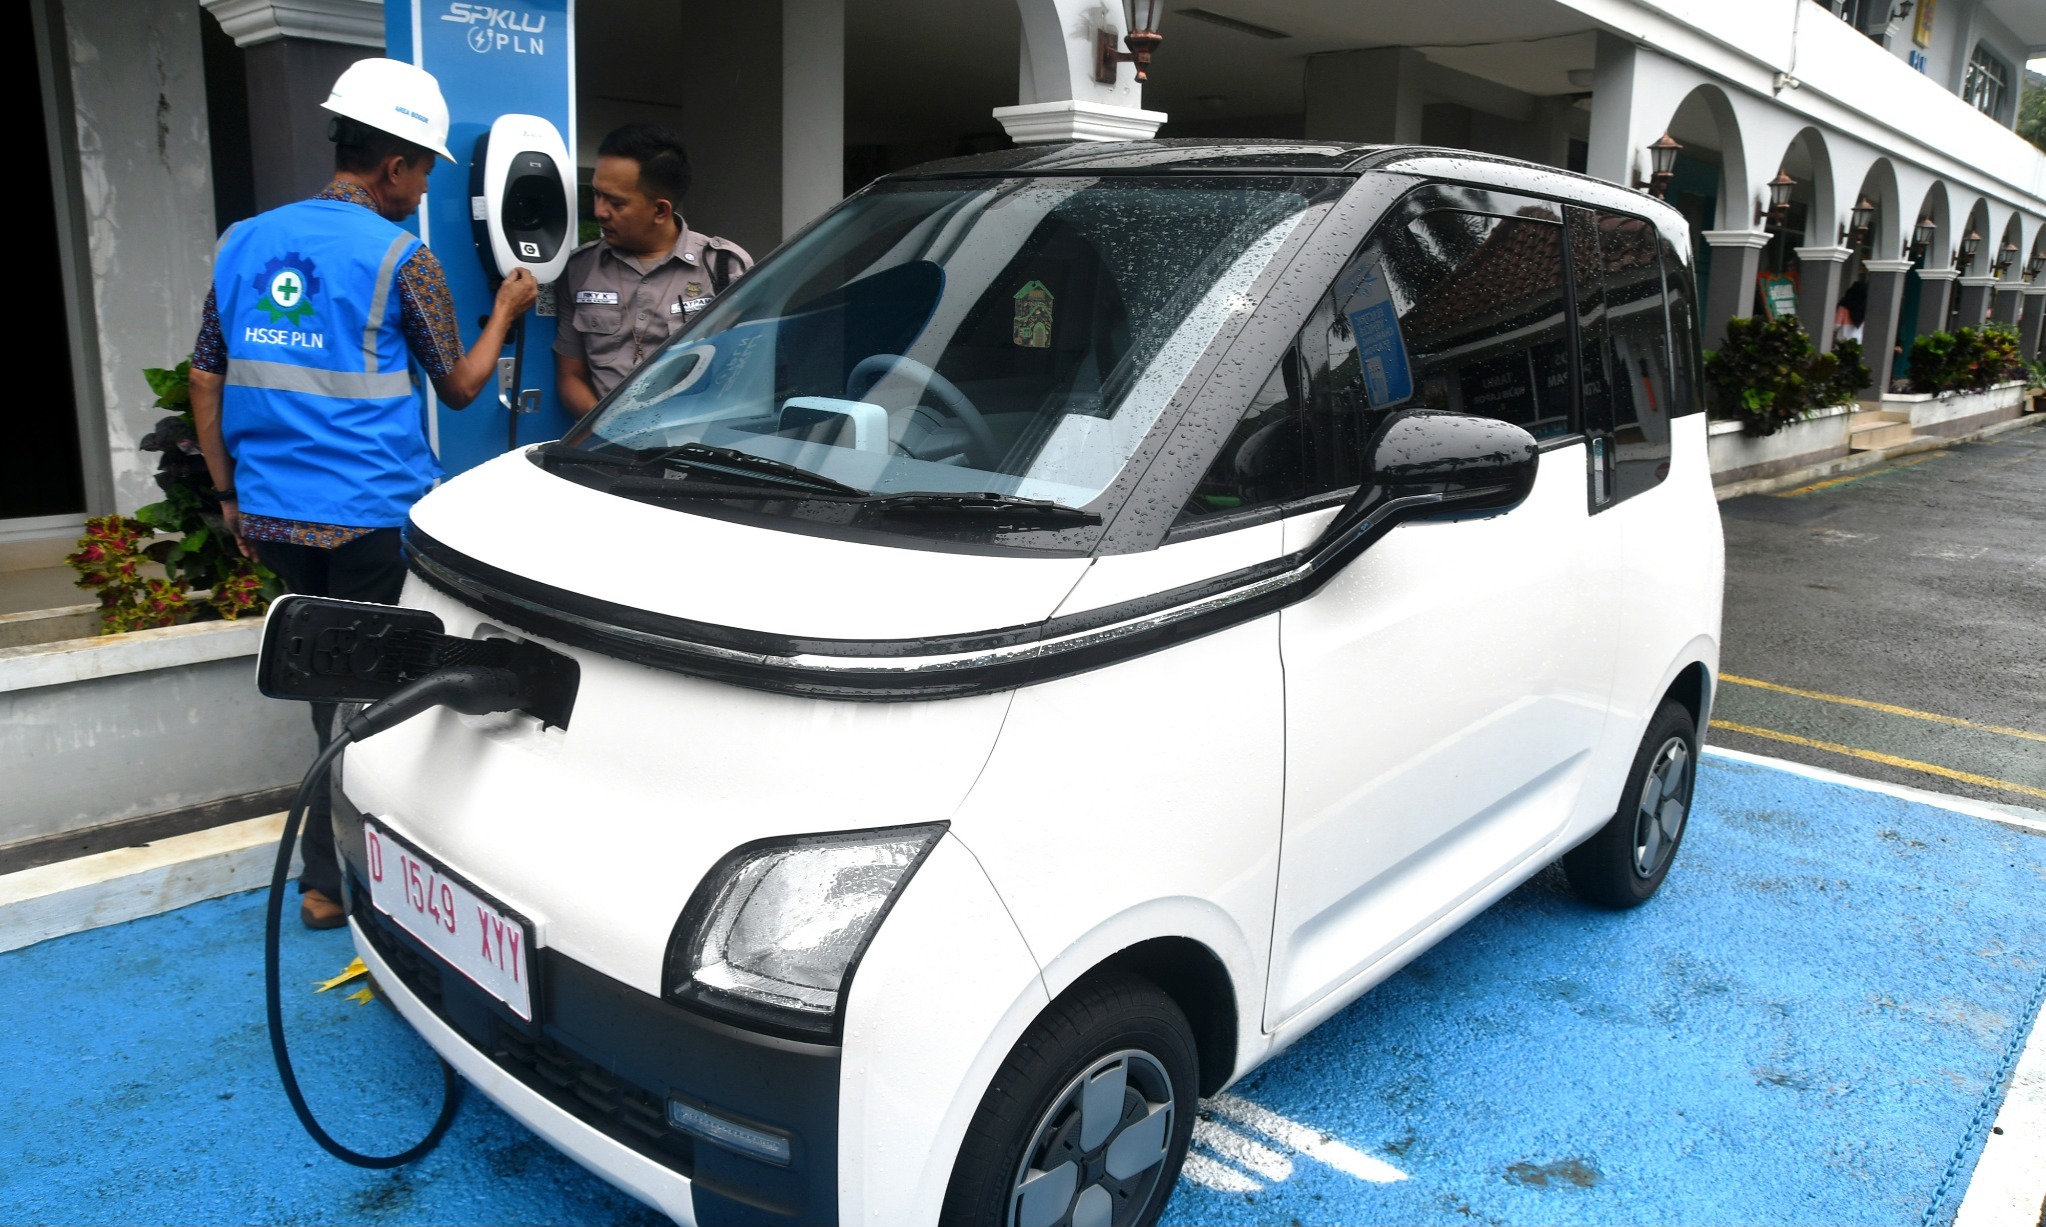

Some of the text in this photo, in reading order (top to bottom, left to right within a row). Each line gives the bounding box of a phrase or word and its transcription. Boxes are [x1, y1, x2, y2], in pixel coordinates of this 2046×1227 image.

[496, 32, 544, 56] PLN
[245, 327, 323, 349] HSSE PLN
[369, 832, 519, 983] D 1549 XYY
